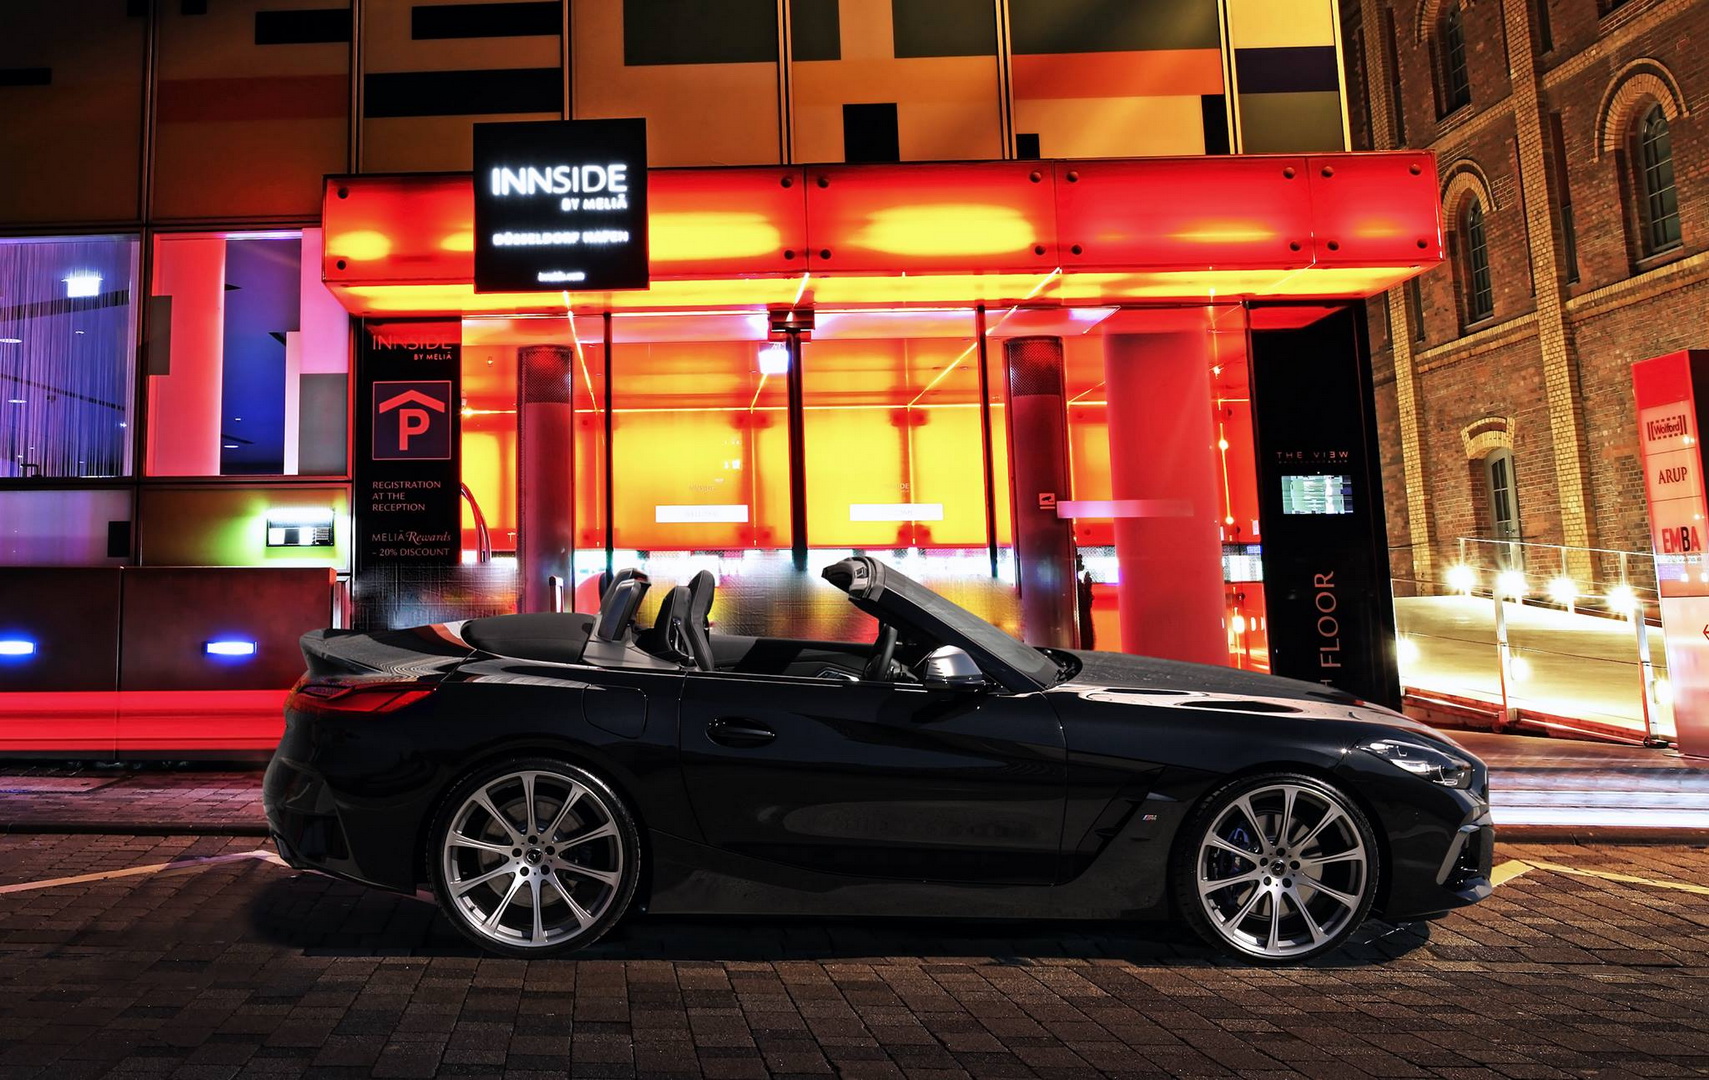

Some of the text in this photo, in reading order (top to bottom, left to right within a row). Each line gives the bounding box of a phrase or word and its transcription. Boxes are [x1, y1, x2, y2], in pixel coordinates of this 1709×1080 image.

[492, 165, 627, 195] INNSIDE
[561, 198, 579, 211] BY
[399, 409, 430, 450] P
[1276, 451, 1303, 459] THE
[1658, 467, 1688, 485] ARUP
[372, 480, 441, 489] REGISTRATION
[372, 492, 405, 500] AT THE
[372, 503, 425, 512] RECEPTION
[405, 531, 451, 545] Rewards
[1661, 526, 1701, 554] EMBA
[379, 548, 398, 556] 20%
[399, 547, 450, 556] DISCOUNT
[1313, 571, 1342, 668] FLOOR
